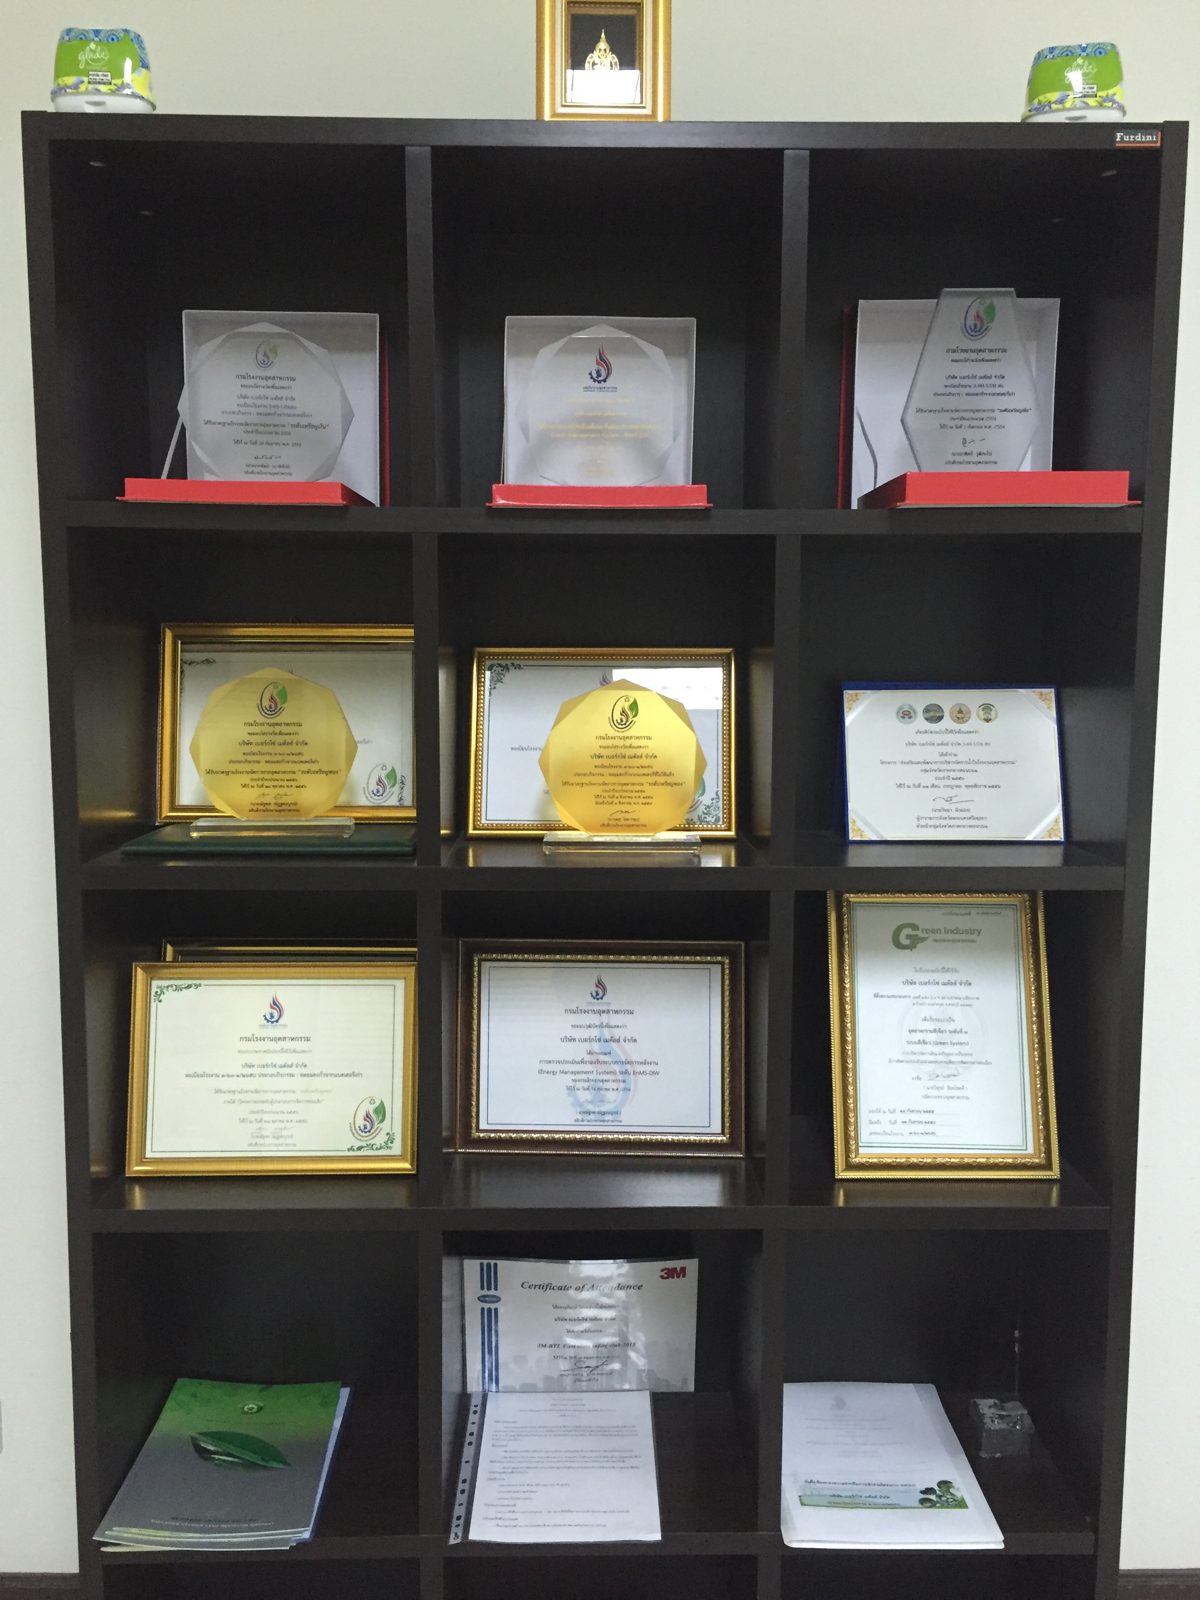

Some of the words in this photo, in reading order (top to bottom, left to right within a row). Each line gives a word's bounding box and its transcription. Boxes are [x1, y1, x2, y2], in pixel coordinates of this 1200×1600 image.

[78, 44, 109, 69] glade
[1116, 132, 1156, 141] Furdini
[943, 926, 982, 937] Industry
[564, 1006, 635, 1017] กรมโรงงานอุตสาหกรรม
[559, 1069, 594, 1077] Management
[659, 1266, 687, 1280] 3M
[520, 1281, 572, 1292] Certificate
[574, 1283, 586, 1293] of
